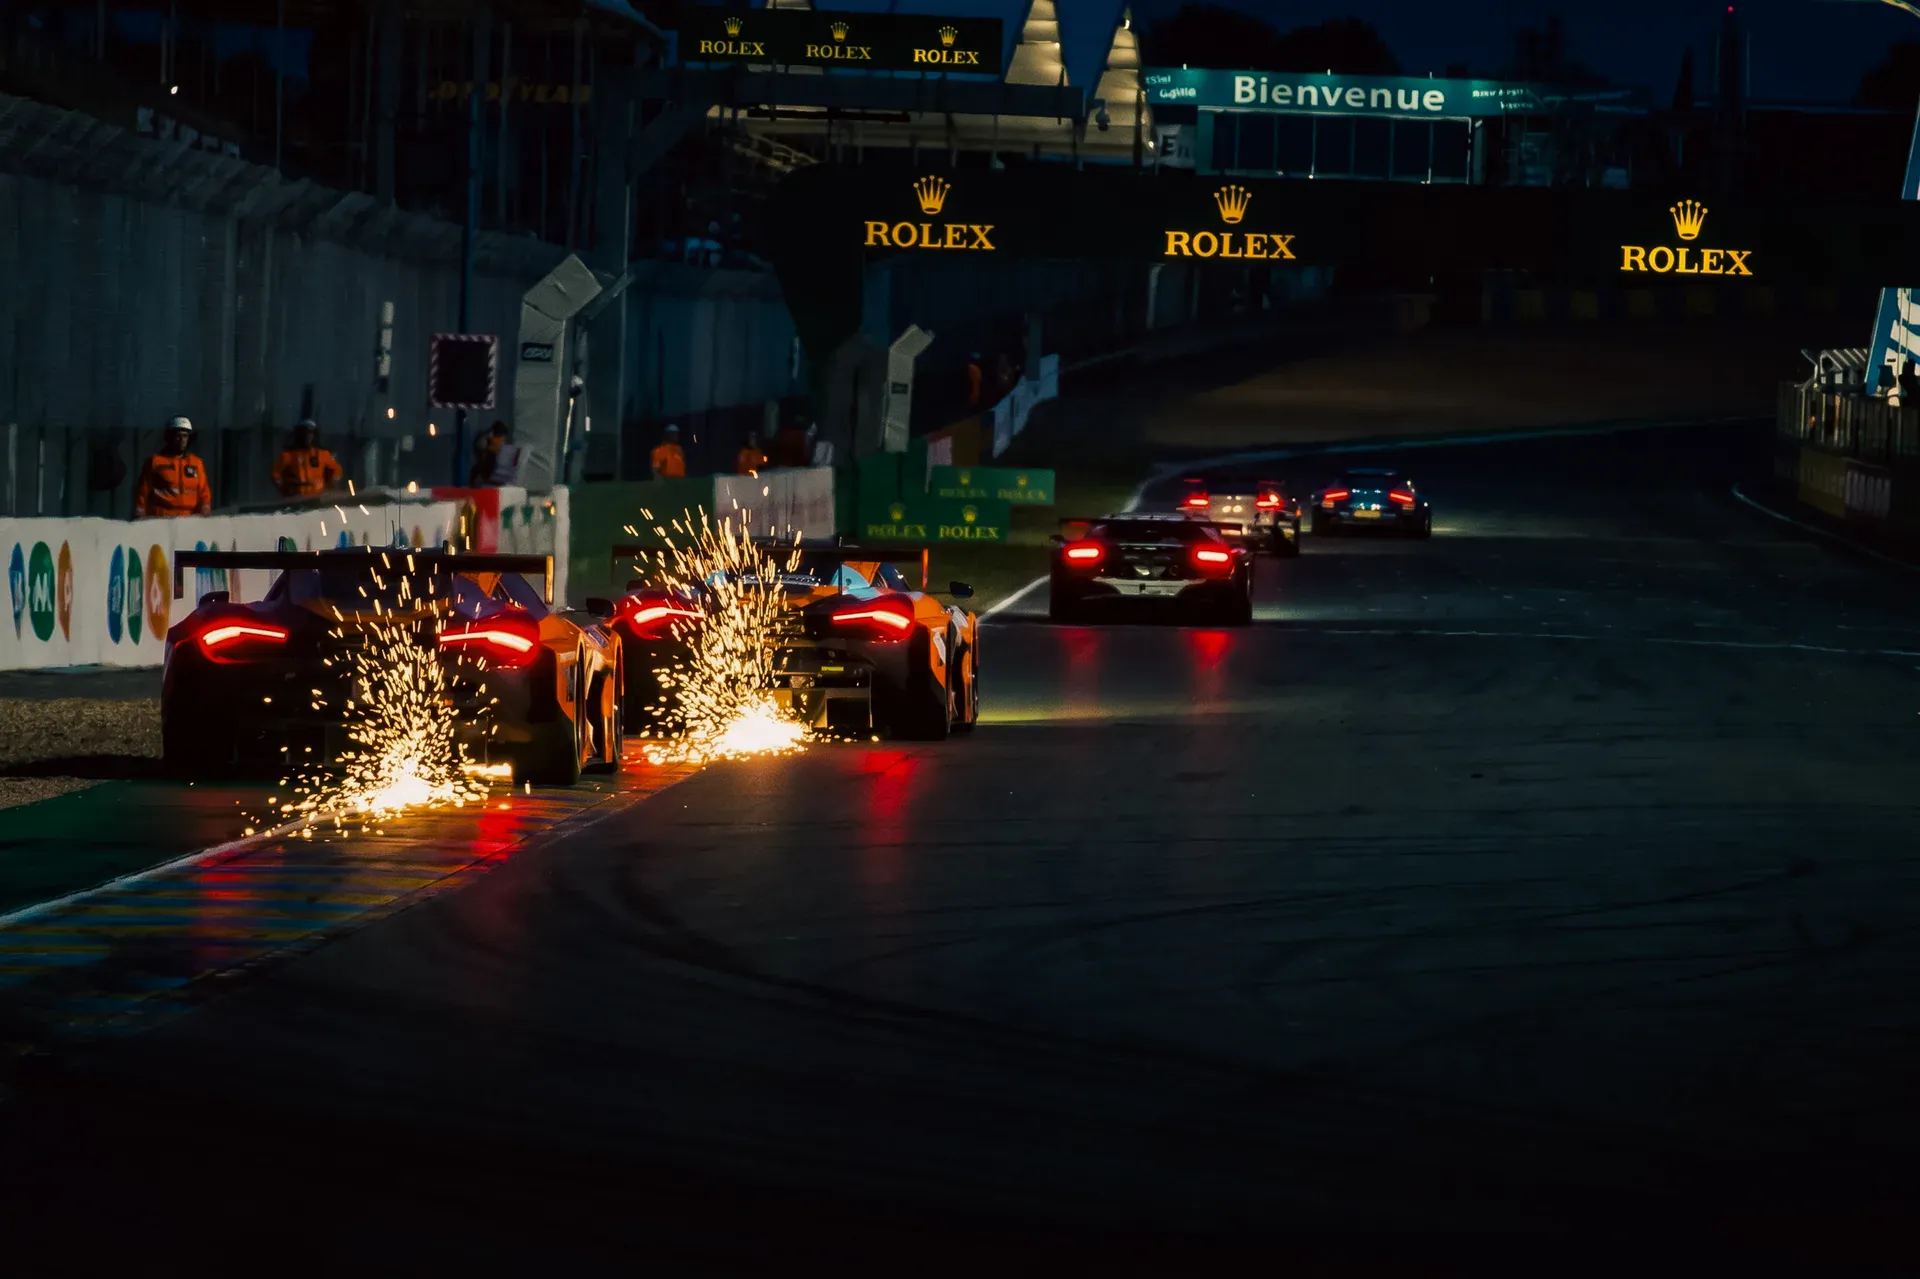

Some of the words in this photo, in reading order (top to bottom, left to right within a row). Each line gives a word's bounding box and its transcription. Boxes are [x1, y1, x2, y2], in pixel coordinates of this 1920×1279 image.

[700, 40, 765, 56] ROLEX
[806, 44, 872, 60] ROLEX
[913, 48, 980, 65] ROLEX
[1233, 75, 1446, 112] Bienvenue
[864, 220, 996, 251] ROLEX
[1164, 230, 1297, 260] ROLEX
[1620, 245, 1754, 277] ROLEX
[866, 523, 926, 538] ROLEX
[938, 524, 999, 540] ROLEX
